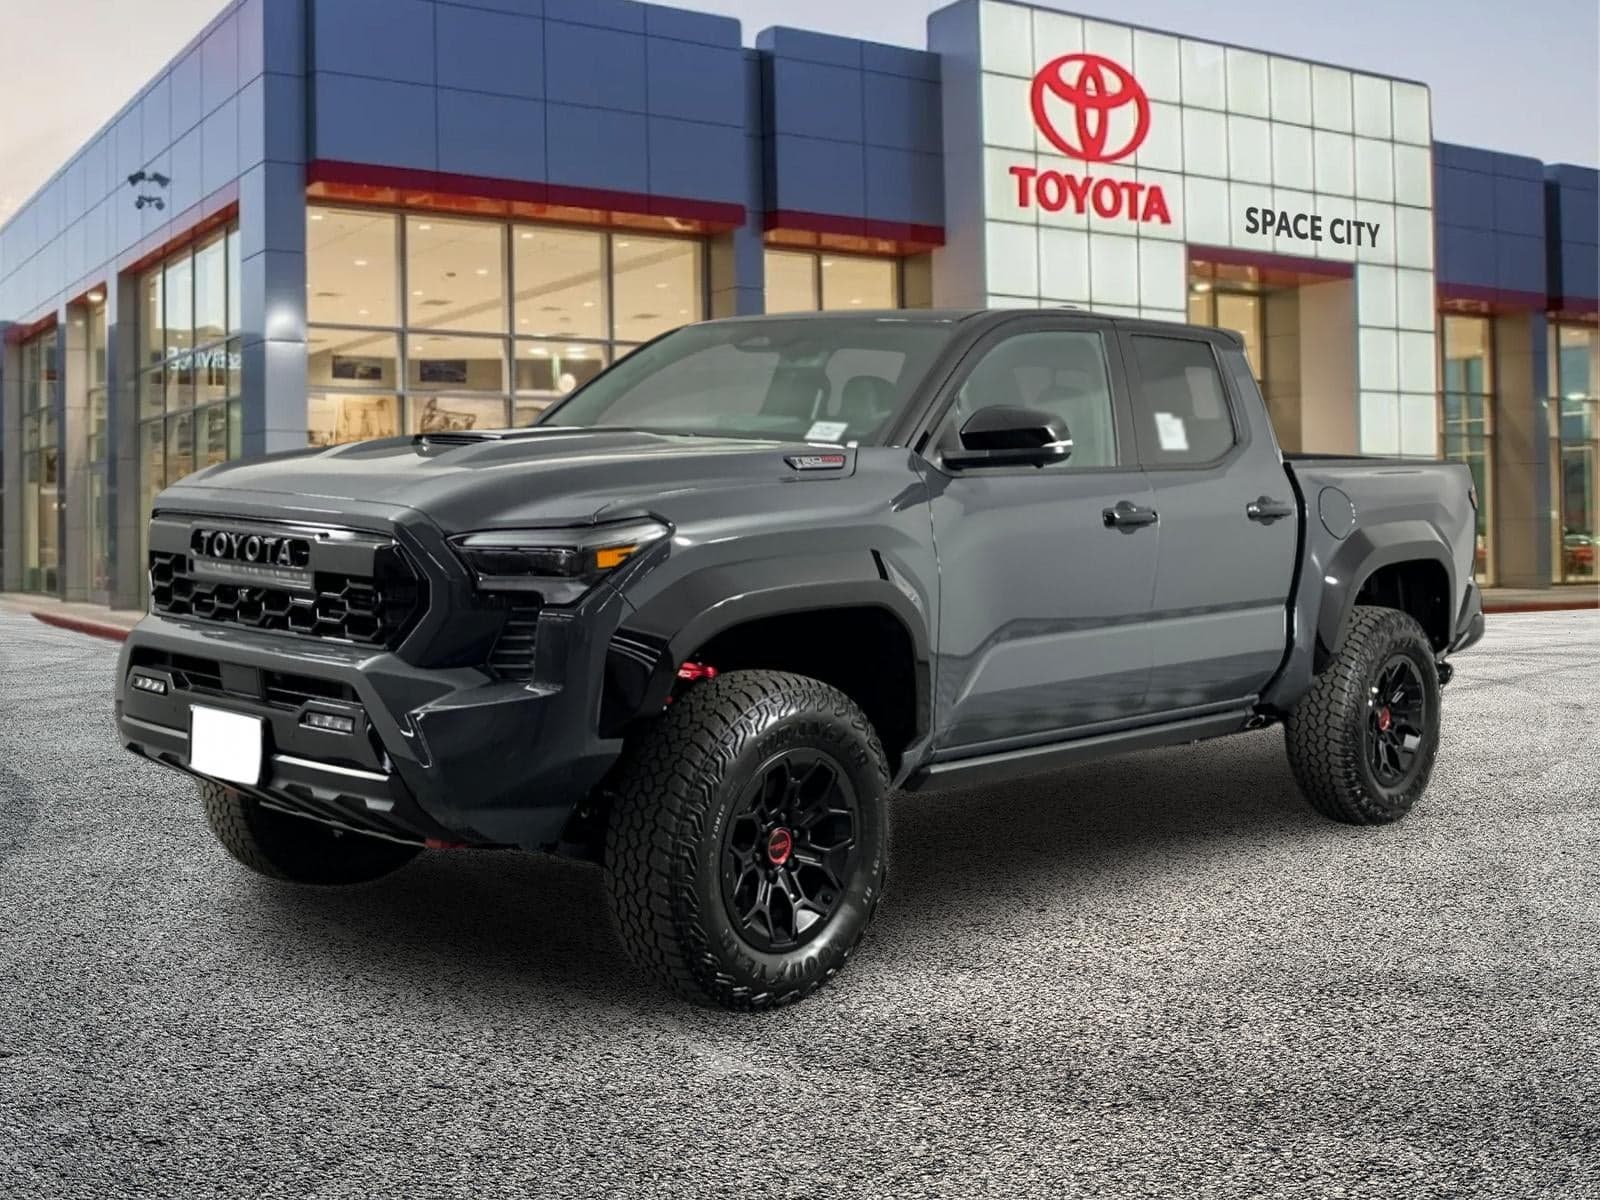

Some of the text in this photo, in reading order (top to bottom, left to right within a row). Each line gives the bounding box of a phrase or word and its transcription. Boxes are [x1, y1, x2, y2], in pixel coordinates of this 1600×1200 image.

[1009, 166, 1172, 225] TOYOTA
[1245, 206, 1381, 248] SPACE CITY
[200, 530, 293, 567] TOYOTA
